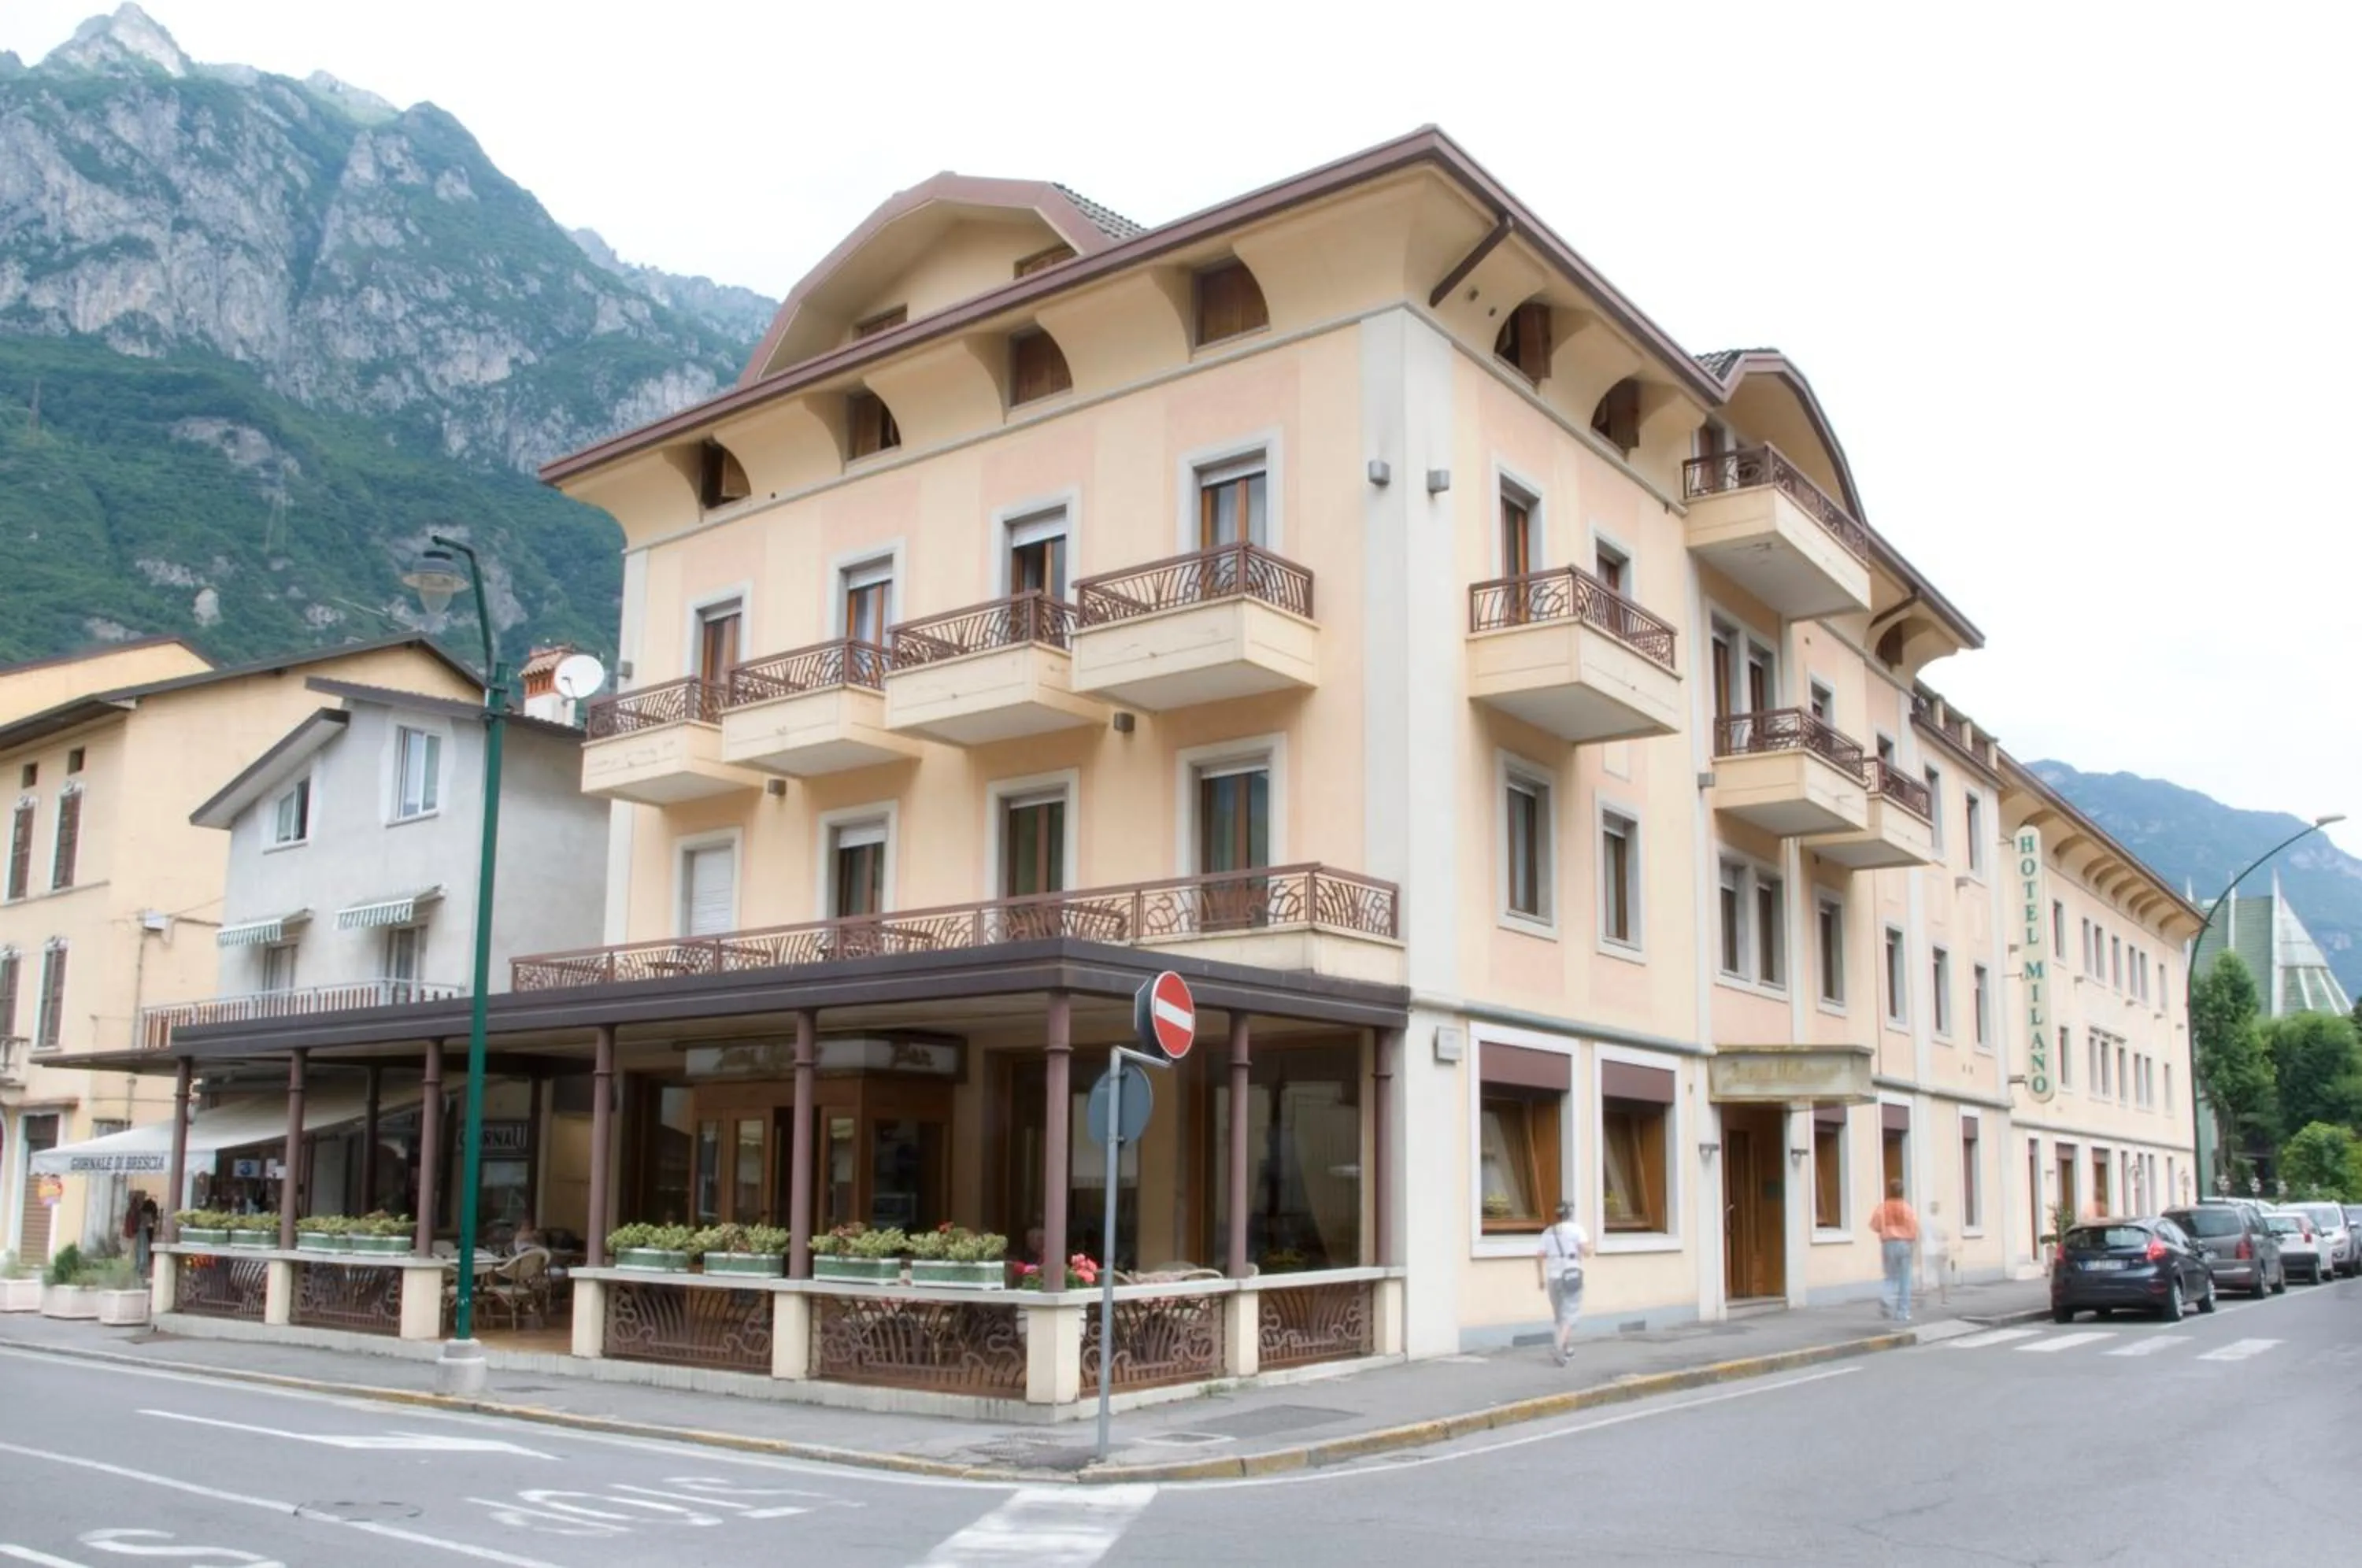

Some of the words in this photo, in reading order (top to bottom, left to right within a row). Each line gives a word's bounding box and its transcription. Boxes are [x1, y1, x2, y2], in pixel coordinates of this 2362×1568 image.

[2020, 835, 2039, 945] HOTEL
[2024, 960, 2047, 1093] MILANO
[71, 1156, 113, 1170] GIORNALE
[127, 1156, 164, 1170] BRESCIA
